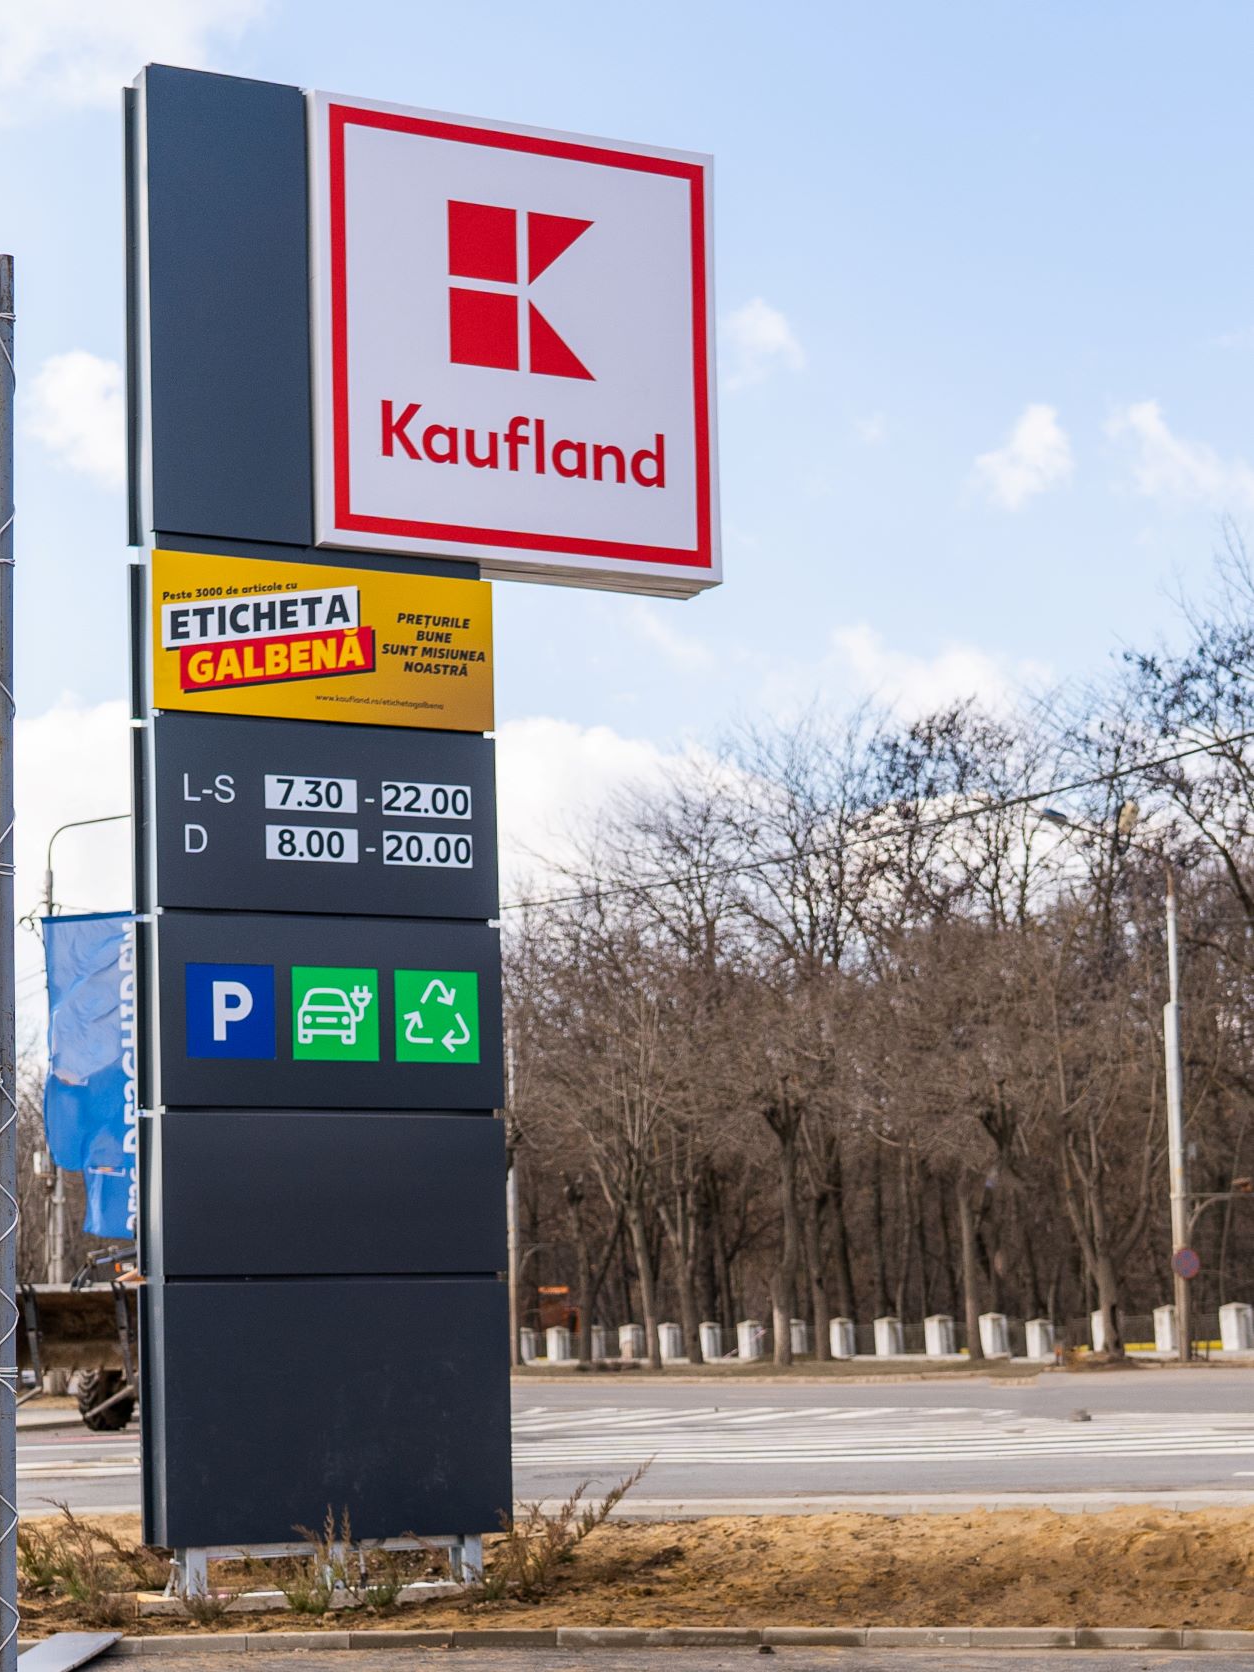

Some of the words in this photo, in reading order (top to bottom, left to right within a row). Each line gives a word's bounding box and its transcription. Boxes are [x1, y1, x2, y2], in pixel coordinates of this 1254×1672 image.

[381, 399, 666, 488] Kaufland
[162, 591, 192, 600] Peste
[195, 587, 223, 597] 3000
[226, 585, 238, 595] de
[241, 582, 282, 594] articole
[170, 594, 350, 641] ETICHETA
[397, 612, 471, 629] PREȚURILE
[416, 630, 452, 643] BUNE
[187, 628, 365, 684] GALBENĂ
[381, 643, 418, 656] SUNT
[421, 646, 486, 662] MISIUNEA
[403, 661, 468, 676] NOASTRĂ
[183, 773, 236, 803] L-S
[276, 778, 343, 809] 7.30
[383, 784, 469, 816] 22.00
[184, 823, 208, 853] D
[277, 829, 345, 859] 8.00
[385, 834, 471, 864] 20.00
[212, 980, 253, 1041] P
